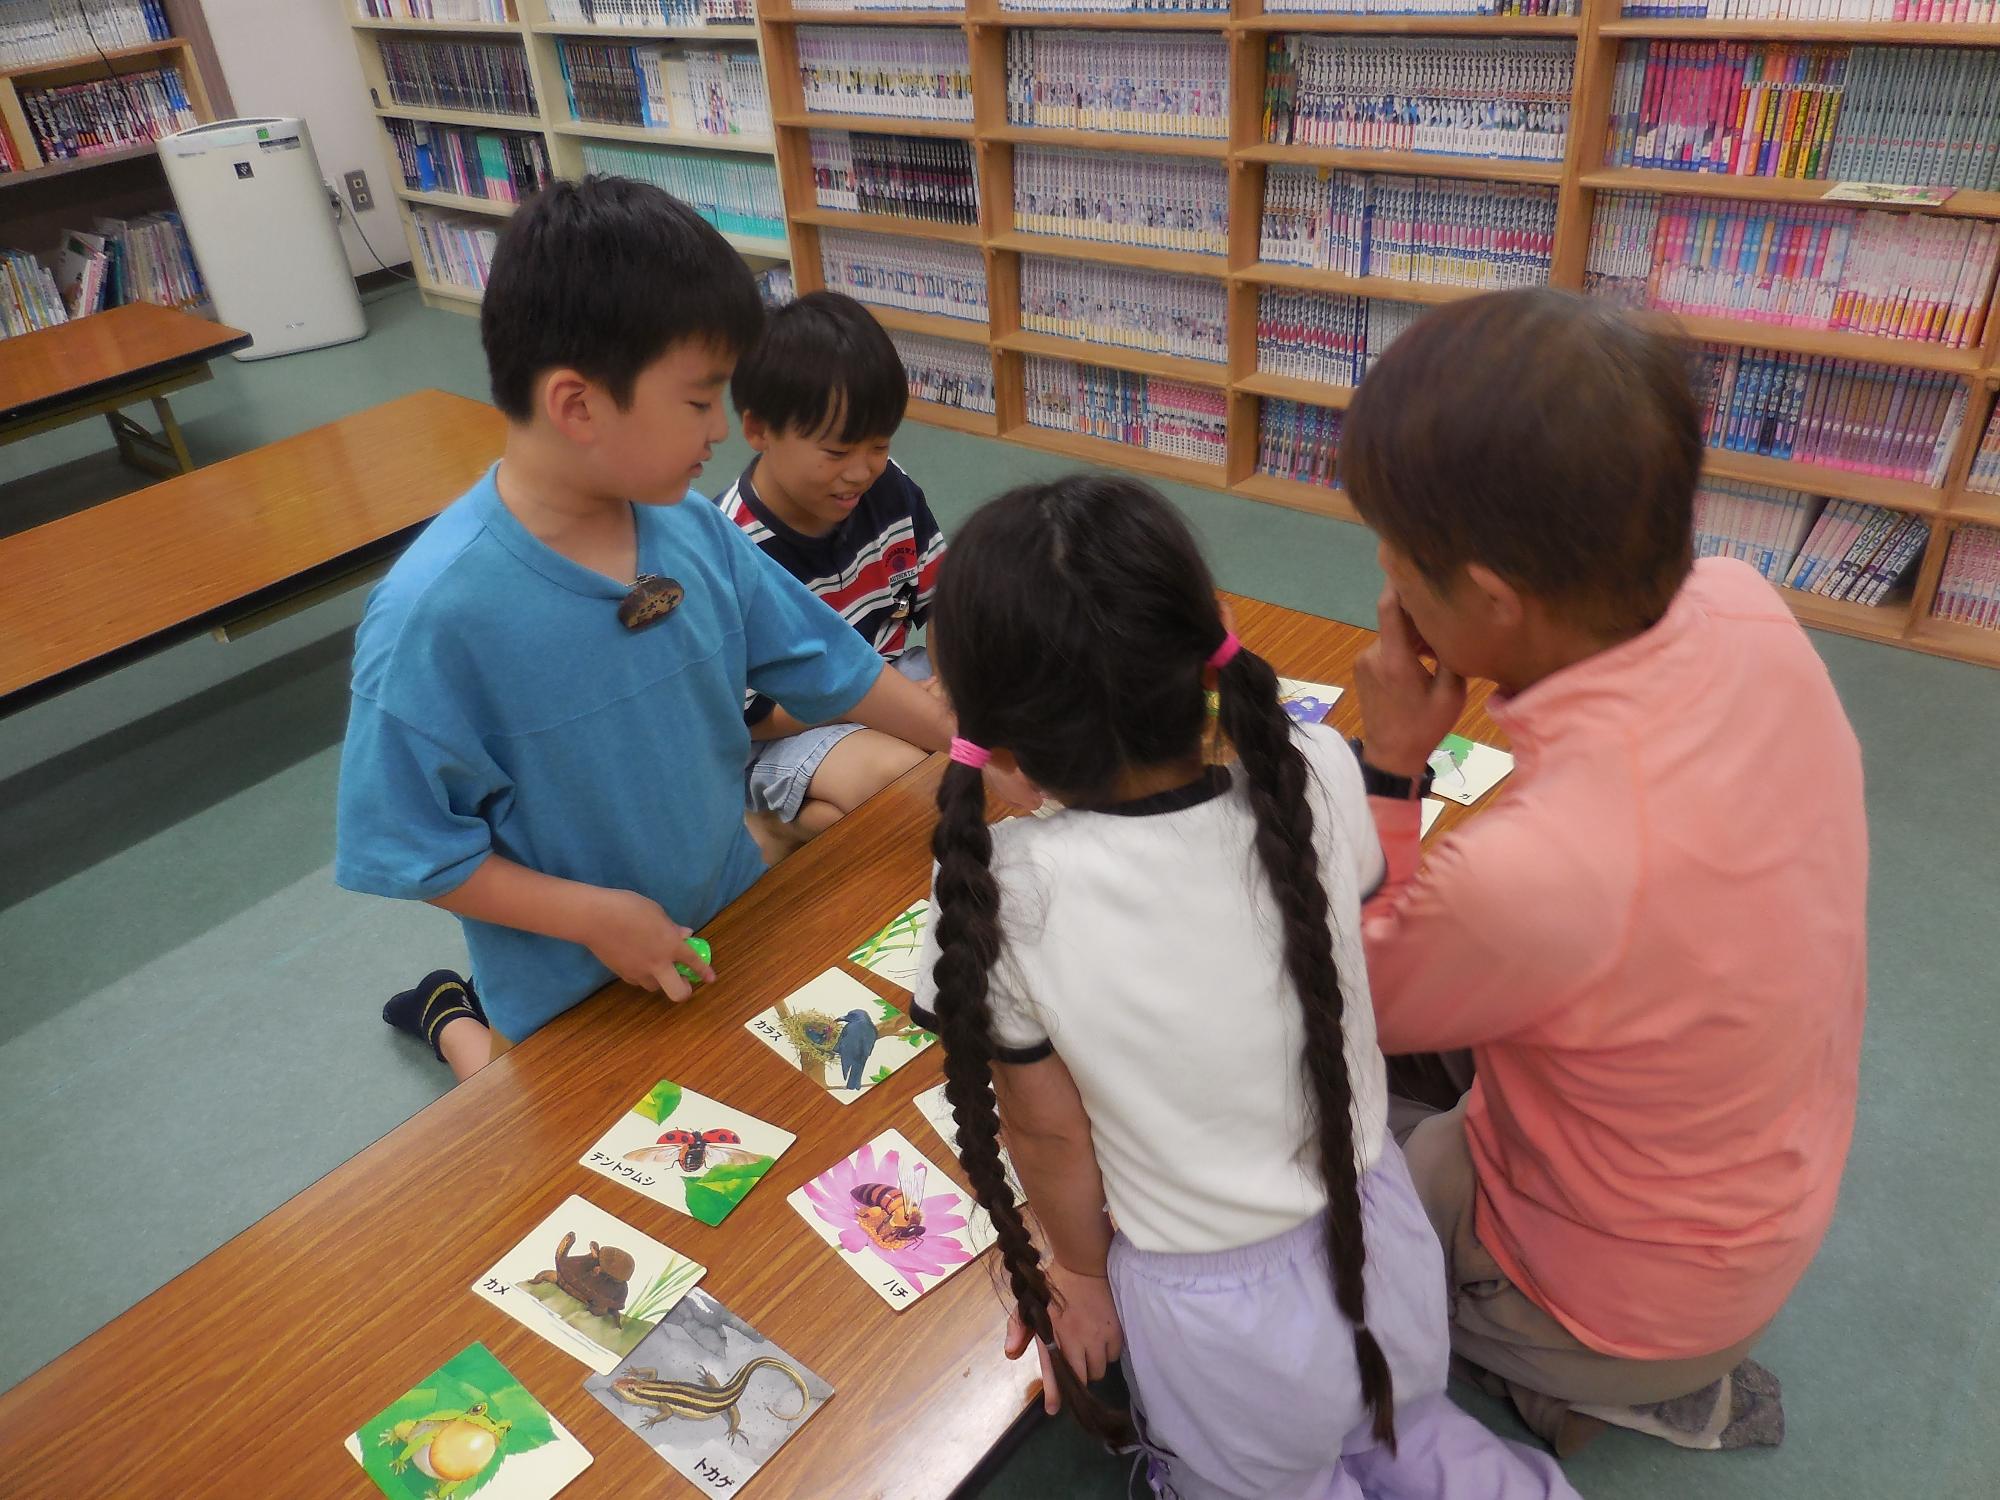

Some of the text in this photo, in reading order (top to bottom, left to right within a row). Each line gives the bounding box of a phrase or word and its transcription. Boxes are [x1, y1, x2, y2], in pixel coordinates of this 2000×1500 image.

[754, 1020, 782, 1042] カラス
[590, 1151, 656, 1186] テントウムシ
[483, 1278, 510, 1295] カメ
[883, 1279, 909, 1298] ハチ
[694, 1457, 736, 1488] トカゲ
